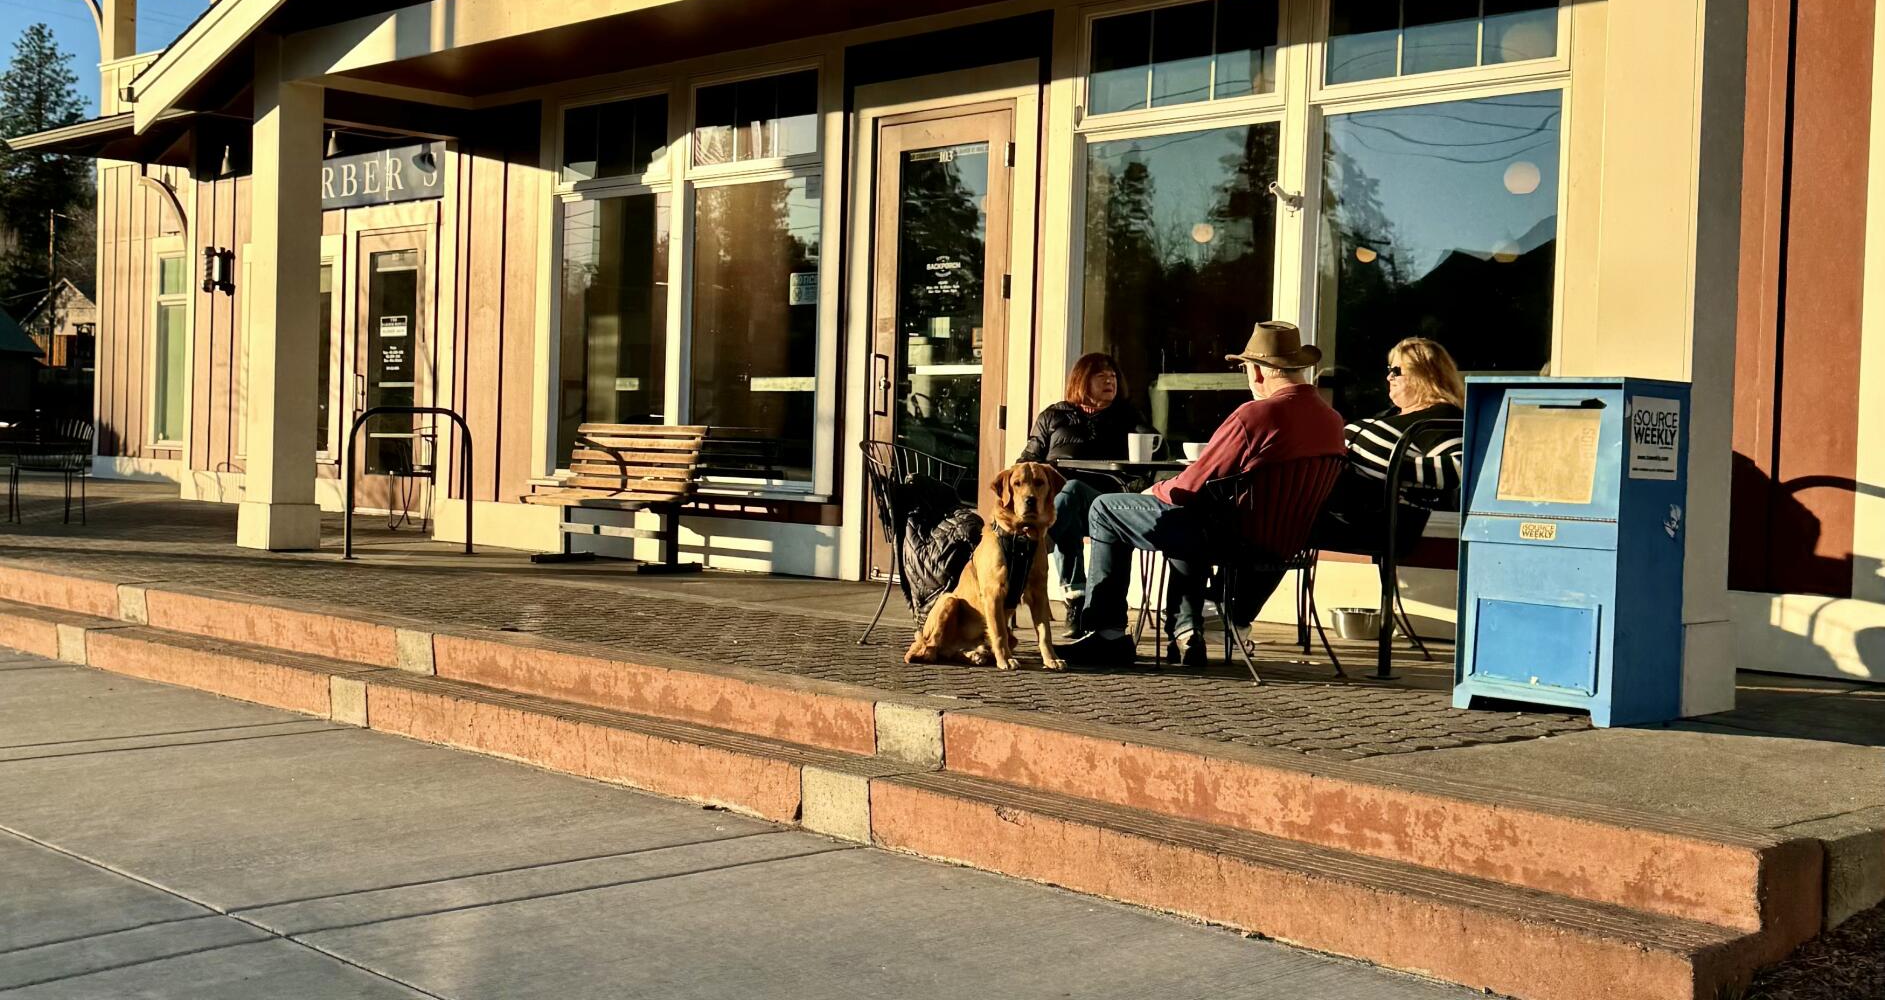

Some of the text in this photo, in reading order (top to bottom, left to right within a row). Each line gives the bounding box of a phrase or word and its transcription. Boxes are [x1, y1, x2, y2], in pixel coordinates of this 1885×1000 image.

[1636, 410, 1678, 428] SOURCE
[1634, 427, 1677, 446] WEEKLY
[1522, 529, 1554, 538] WEEKLY
